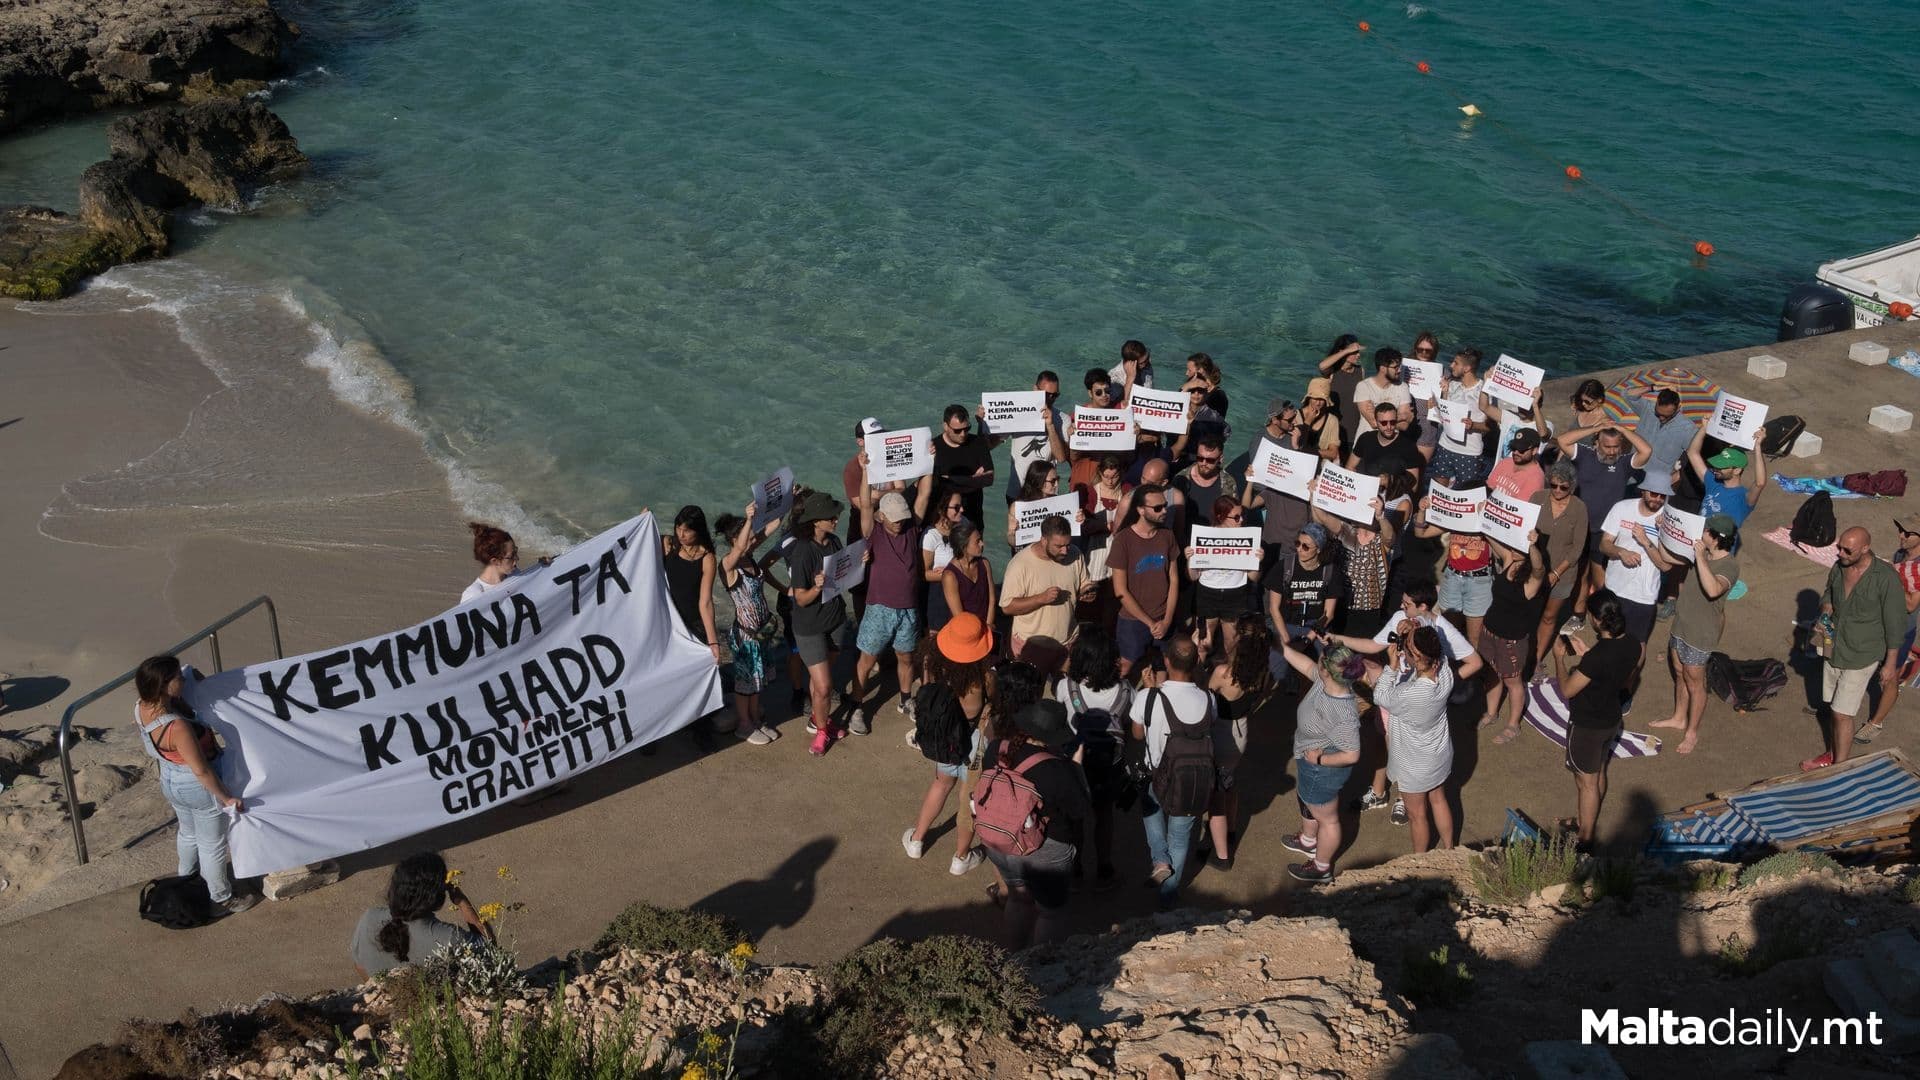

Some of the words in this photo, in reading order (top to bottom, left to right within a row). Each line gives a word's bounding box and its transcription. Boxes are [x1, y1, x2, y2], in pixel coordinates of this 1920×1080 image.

[1145, 409, 1182, 420] DRITT
[1432, 488, 1451, 502] RISE
[1021, 507, 1048, 516] TUNA
[1432, 498, 1474, 512] AGAINST
[1432, 506, 1463, 518] GREED
[1486, 503, 1521, 524] AGAINST
[1484, 512, 1510, 530] GREED
[259, 593, 542, 721] KEMMUNA
[442, 709, 633, 815] GRAFFITTI
